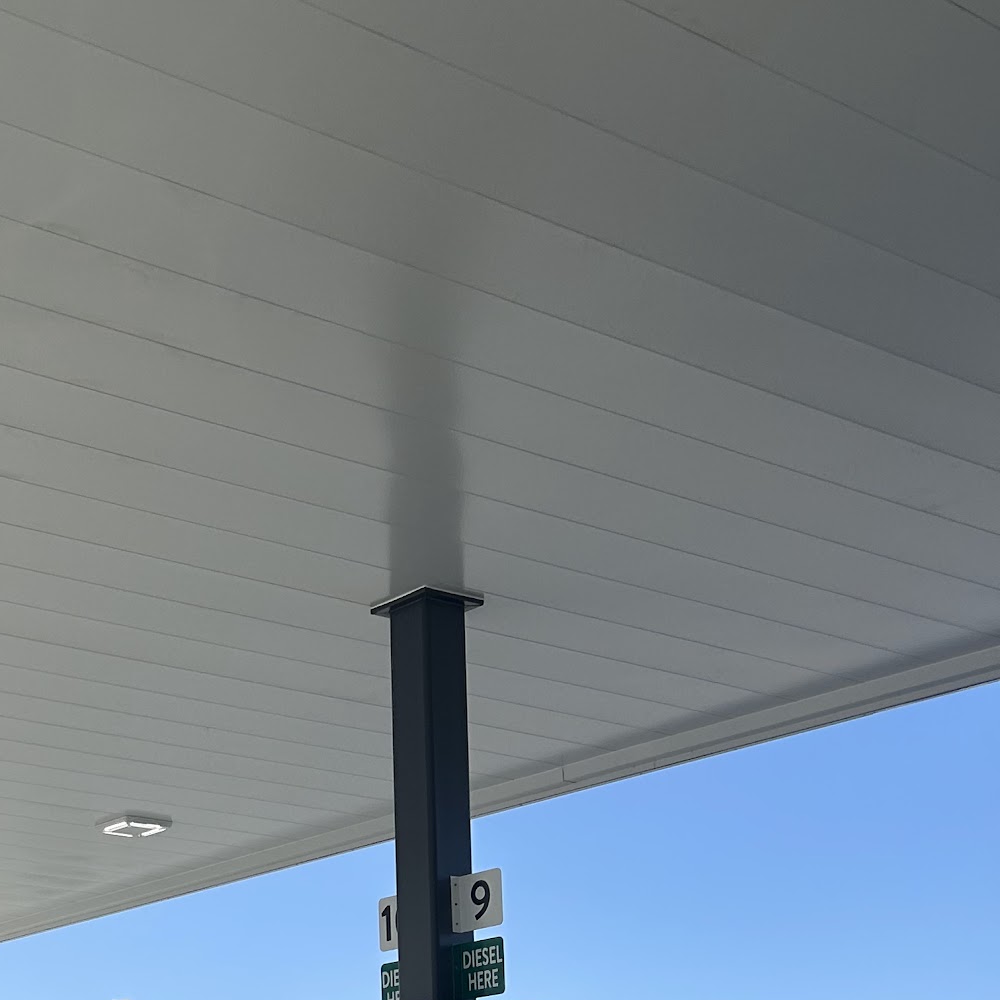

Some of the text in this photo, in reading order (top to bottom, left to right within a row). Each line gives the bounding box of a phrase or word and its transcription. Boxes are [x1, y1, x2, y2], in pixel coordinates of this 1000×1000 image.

[470, 879, 491, 921] 9
[381, 904, 398, 942] 1
[462, 944, 503, 970] DIESEL
[382, 967, 400, 990] DIE
[468, 967, 499, 992] HERE
